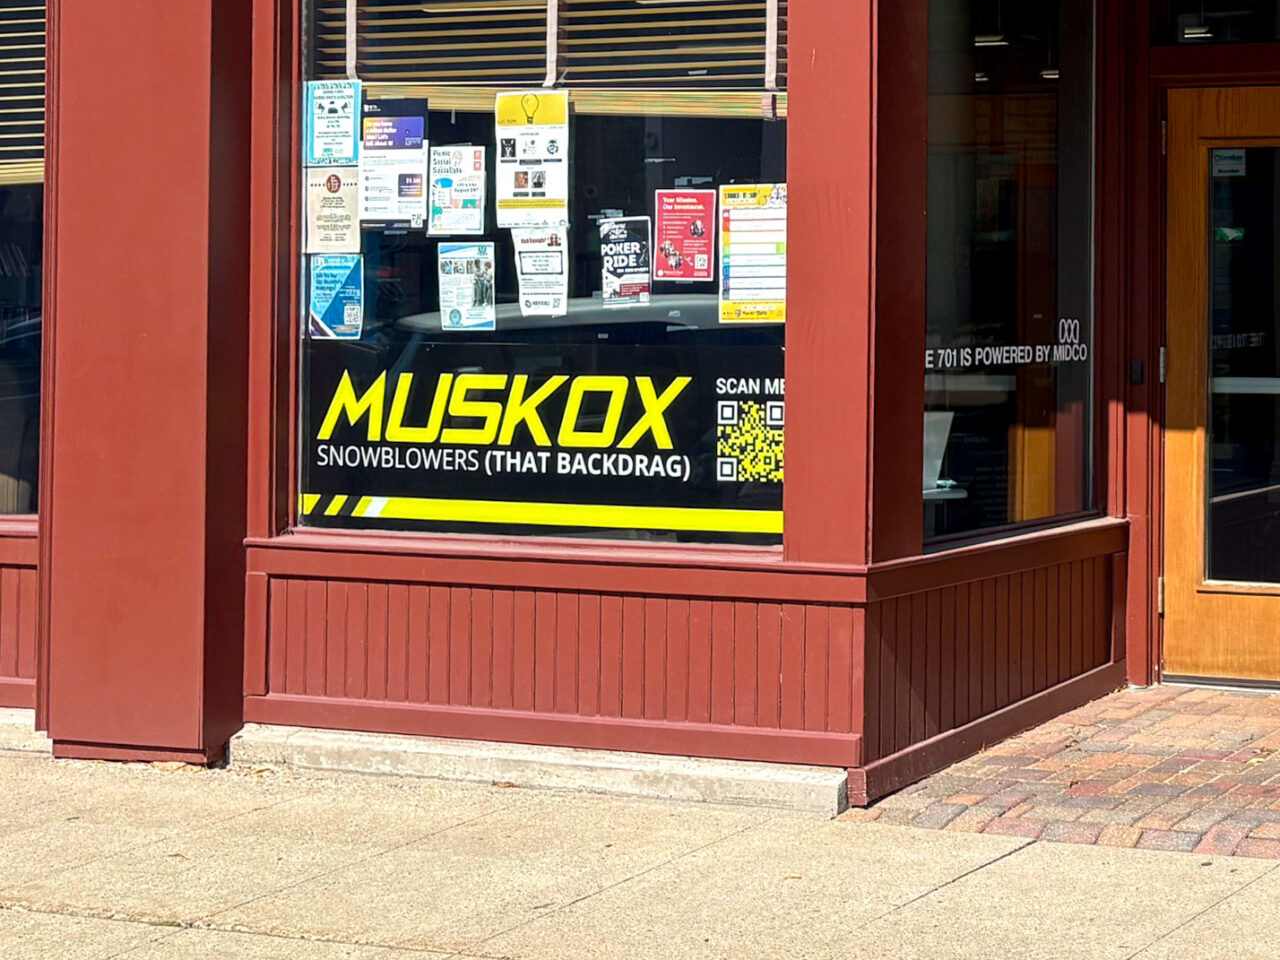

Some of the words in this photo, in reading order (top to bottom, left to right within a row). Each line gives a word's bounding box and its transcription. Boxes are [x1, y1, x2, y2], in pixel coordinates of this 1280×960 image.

[601, 242, 640, 256] POKER
[604, 255, 637, 271] RIDE
[938, 349, 957, 367] 701
[960, 348, 972, 366] IS
[975, 346, 1032, 365] POWERED
[1036, 345, 1051, 362] BY
[1053, 344, 1087, 361] MIDCO
[716, 378, 760, 394] SCAN
[317, 369, 692, 449] MUSKOX
[316, 445, 479, 472] SNOWBLOWERS
[484, 449, 550, 479] (THAT
[557, 451, 690, 481] BACKDRAG)
